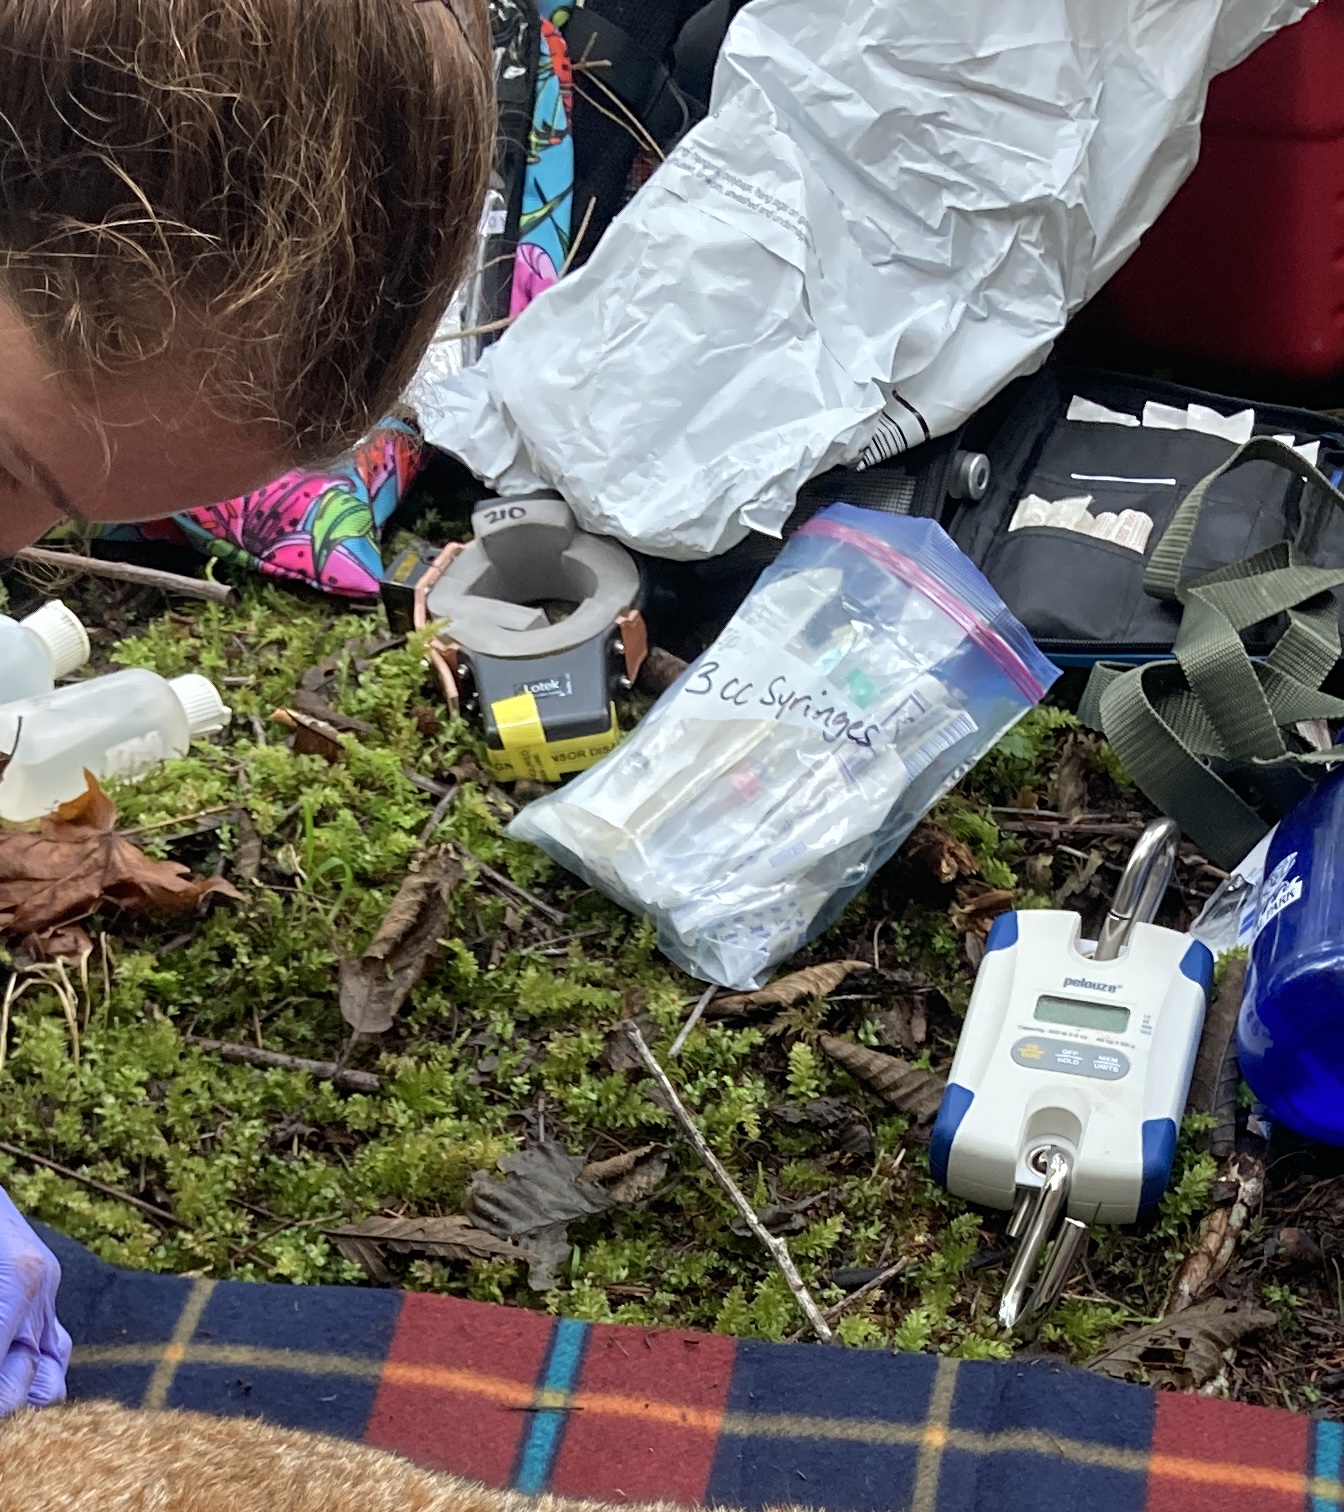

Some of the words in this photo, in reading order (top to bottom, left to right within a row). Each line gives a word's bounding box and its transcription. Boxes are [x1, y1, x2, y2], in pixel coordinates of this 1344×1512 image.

[484, 506, 526, 524] 210
[684, 661, 719, 695] 3
[760, 675, 880, 748] Syringes
[1063, 977, 1118, 993] pelouze
